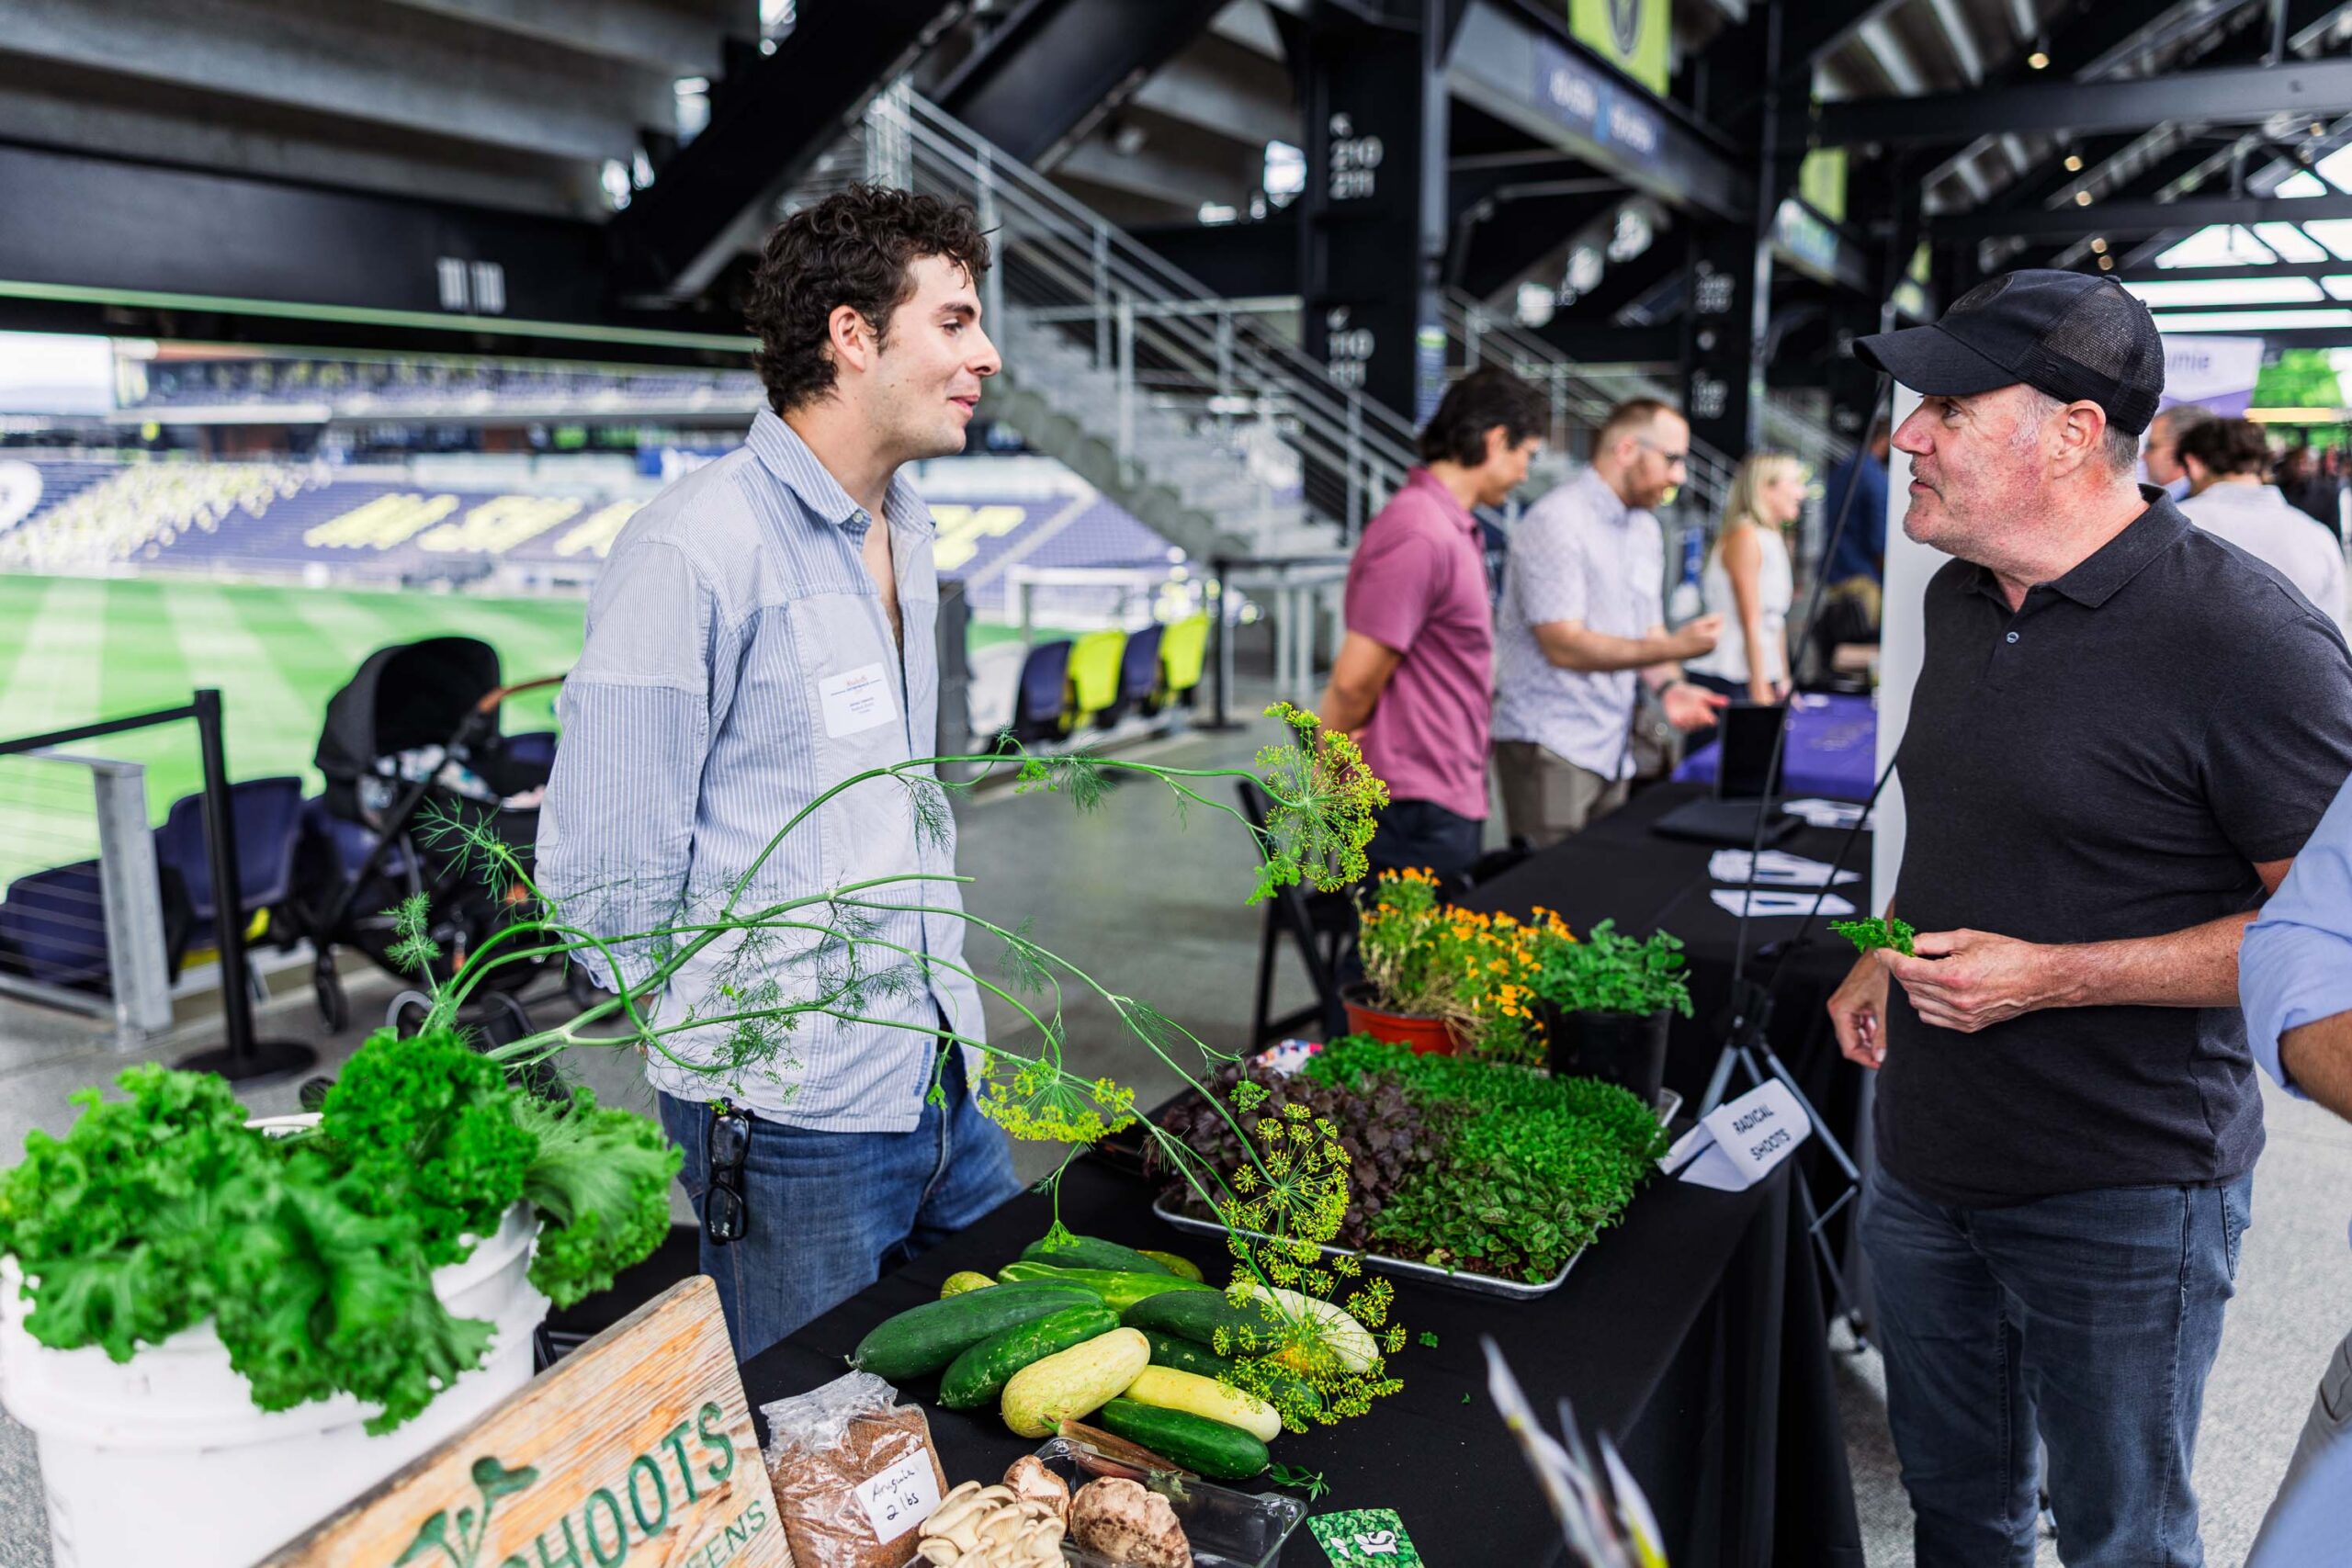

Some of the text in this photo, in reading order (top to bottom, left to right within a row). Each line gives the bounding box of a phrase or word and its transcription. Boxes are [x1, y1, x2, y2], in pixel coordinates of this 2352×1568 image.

[1732, 1105, 1774, 1134] RADICAL
[1749, 1128, 1791, 1160] SHOOTS
[501, 1401, 735, 1568] HOOTS
[887, 1492, 920, 1521] 2 lbs
